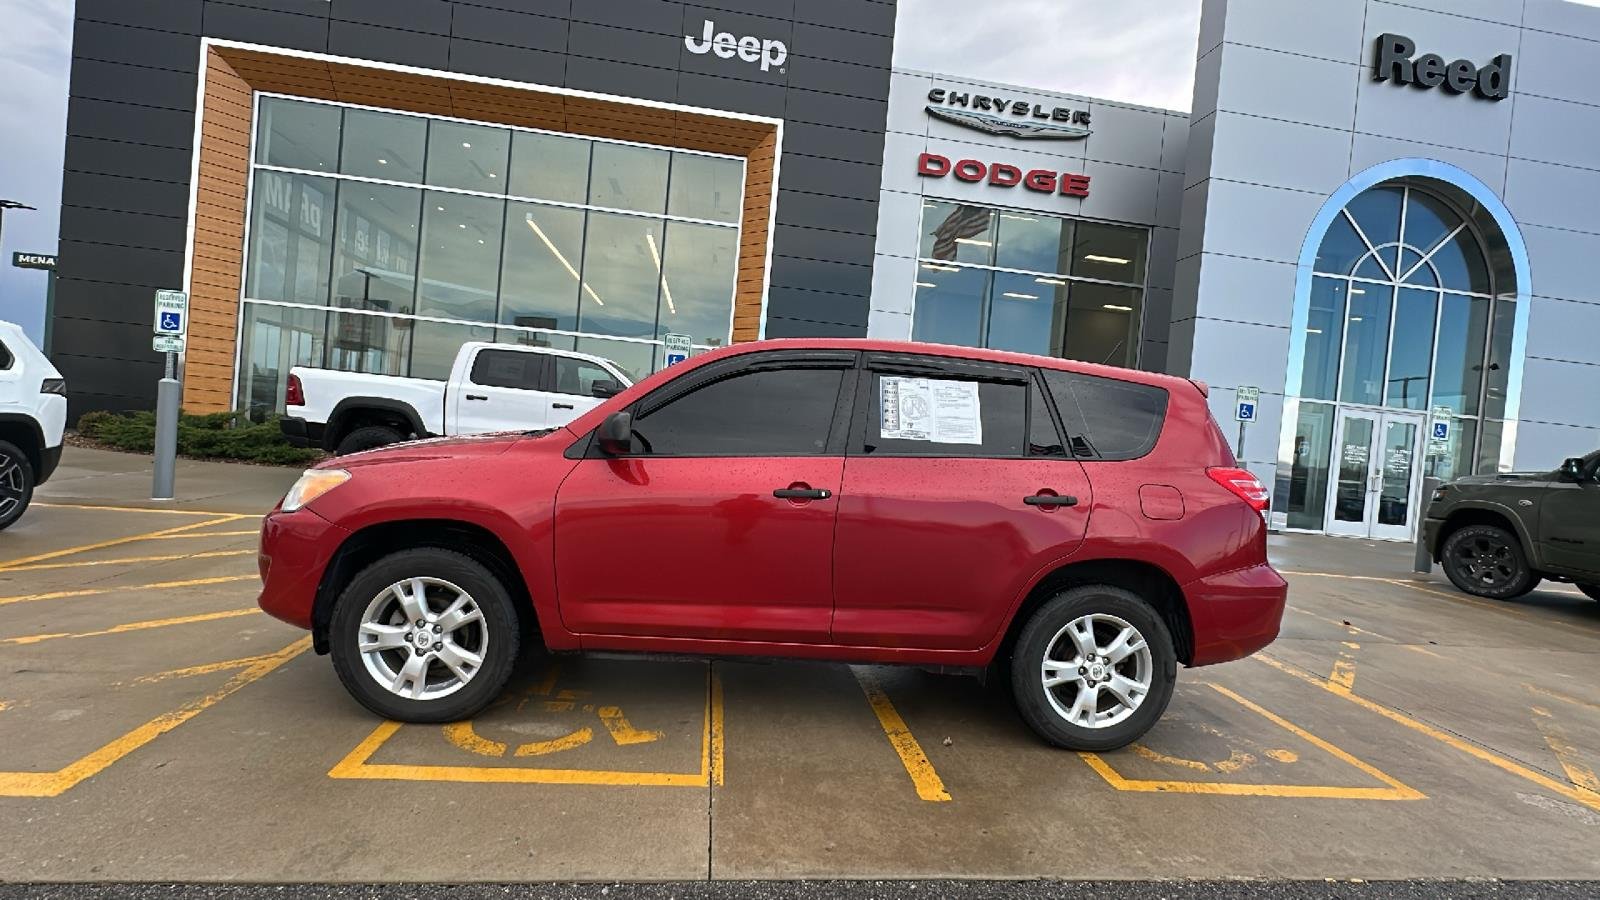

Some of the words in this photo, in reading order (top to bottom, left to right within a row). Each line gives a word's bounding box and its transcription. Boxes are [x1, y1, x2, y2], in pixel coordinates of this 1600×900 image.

[685, 20, 787, 72] Jeep
[1375, 33, 1512, 99] Reed
[928, 88, 1091, 125] CHRYSLER
[918, 153, 1091, 197] DODGE
